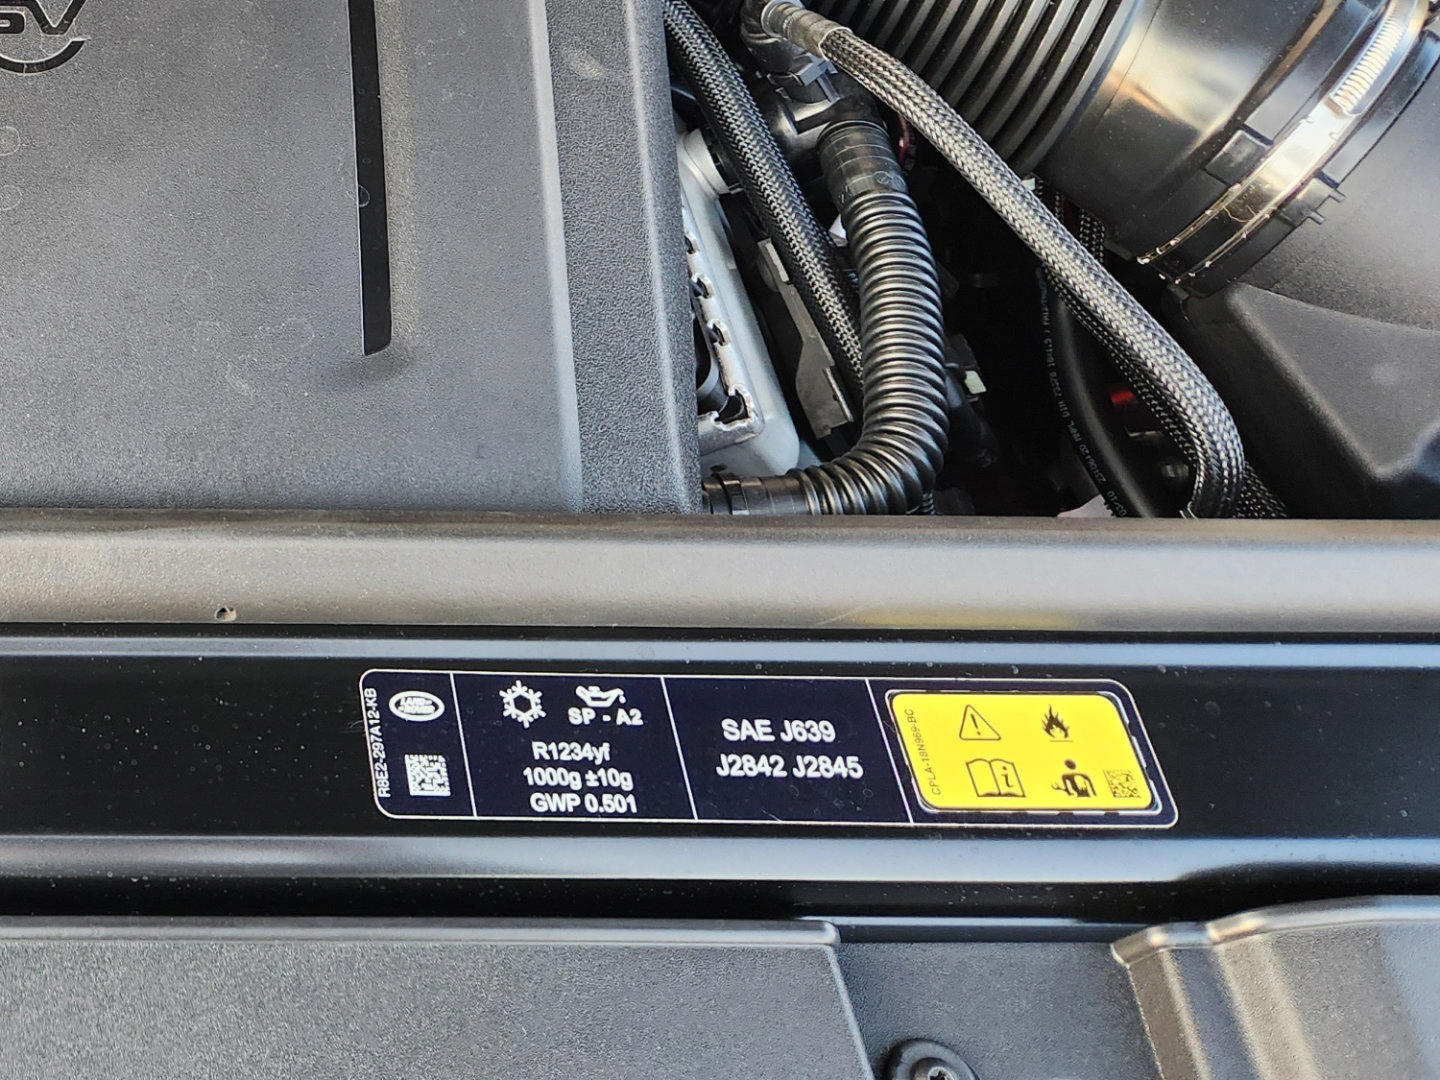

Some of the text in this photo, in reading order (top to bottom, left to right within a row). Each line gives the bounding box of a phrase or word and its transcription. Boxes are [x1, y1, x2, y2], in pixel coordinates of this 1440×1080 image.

[568, 708, 596, 725] SP
[616, 708, 644, 726] A2
[721, 718, 836, 743] SAE J639
[532, 741, 611, 765] R1234yf
[715, 753, 864, 779] J2842 J2845
[523, 767, 634, 791] 1000g ±10g
[530, 794, 638, 814] GWP 0.501
